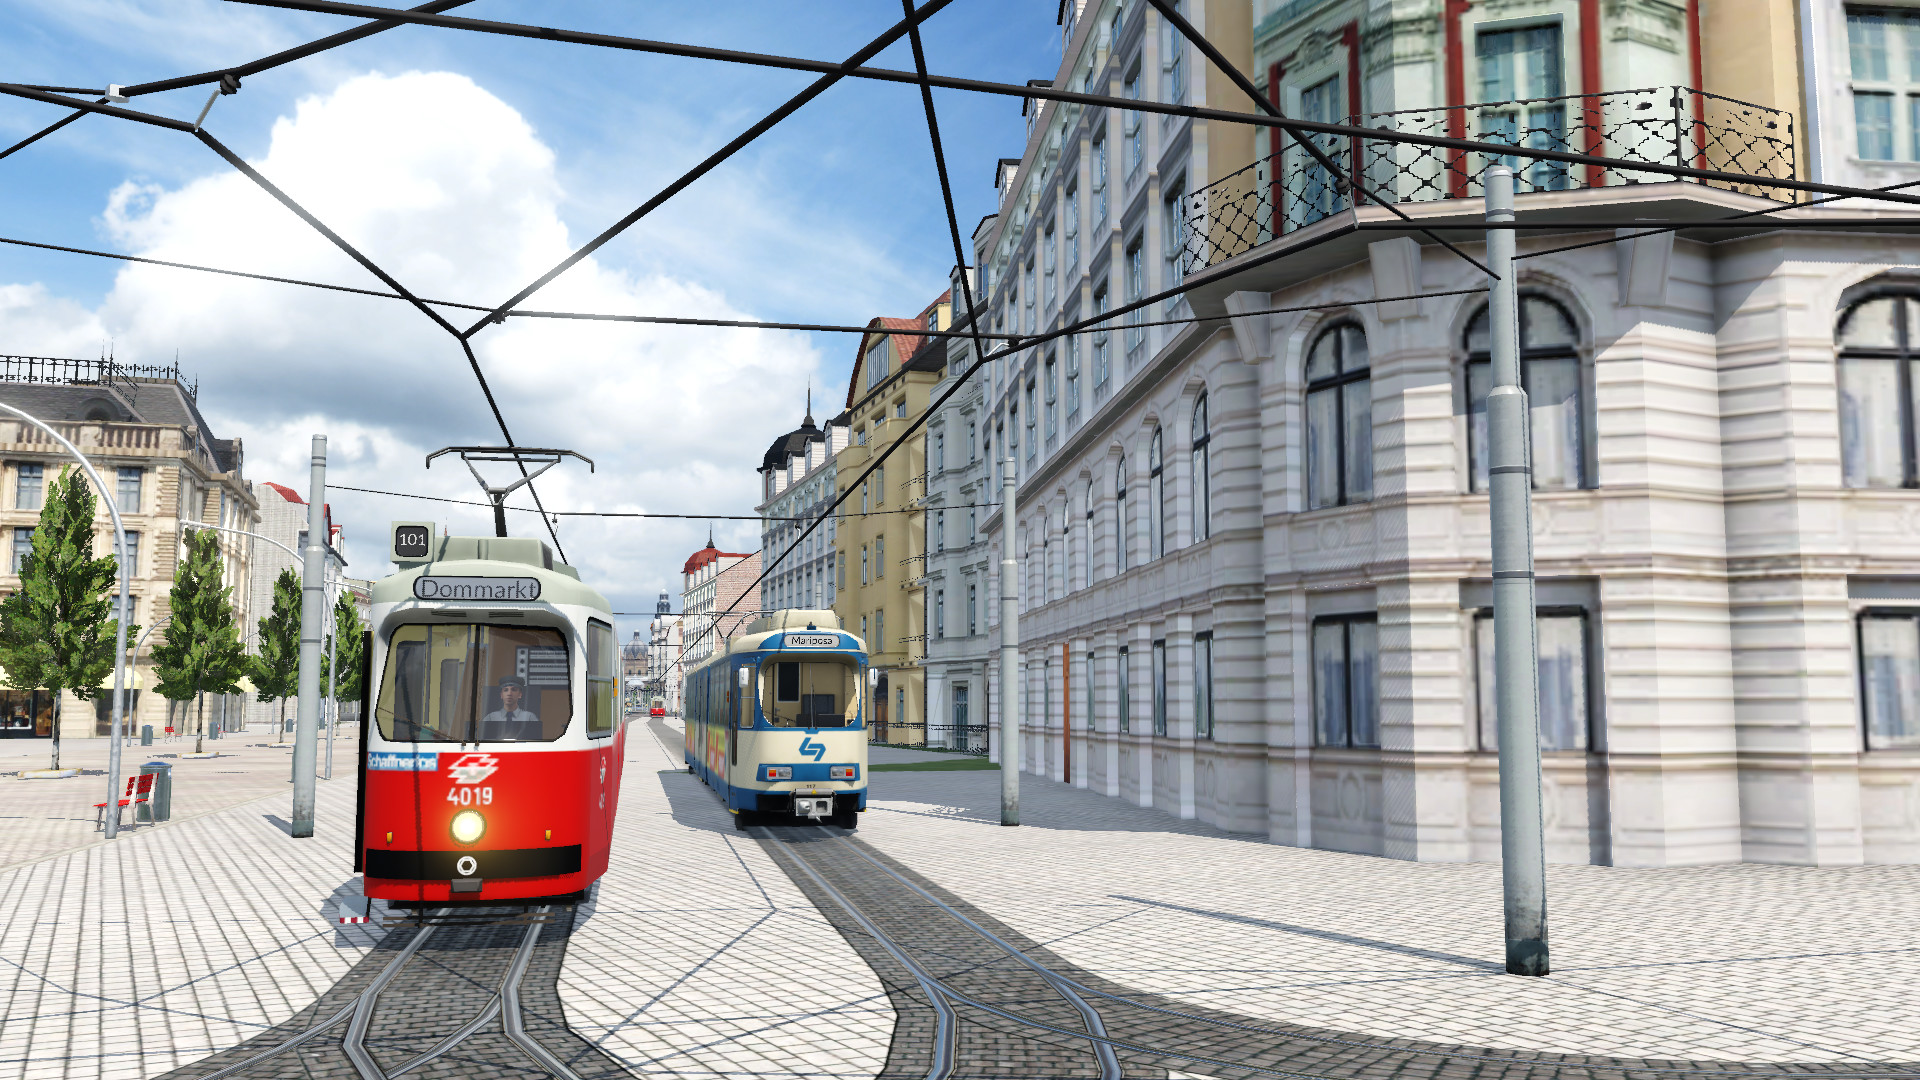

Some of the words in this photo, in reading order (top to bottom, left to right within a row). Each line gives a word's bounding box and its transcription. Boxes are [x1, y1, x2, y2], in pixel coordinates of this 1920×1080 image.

[400, 533, 426, 546] 101
[421, 579, 536, 598] Dommarkt
[791, 636, 833, 646] Mariposa
[446, 787, 493, 806] 4019
